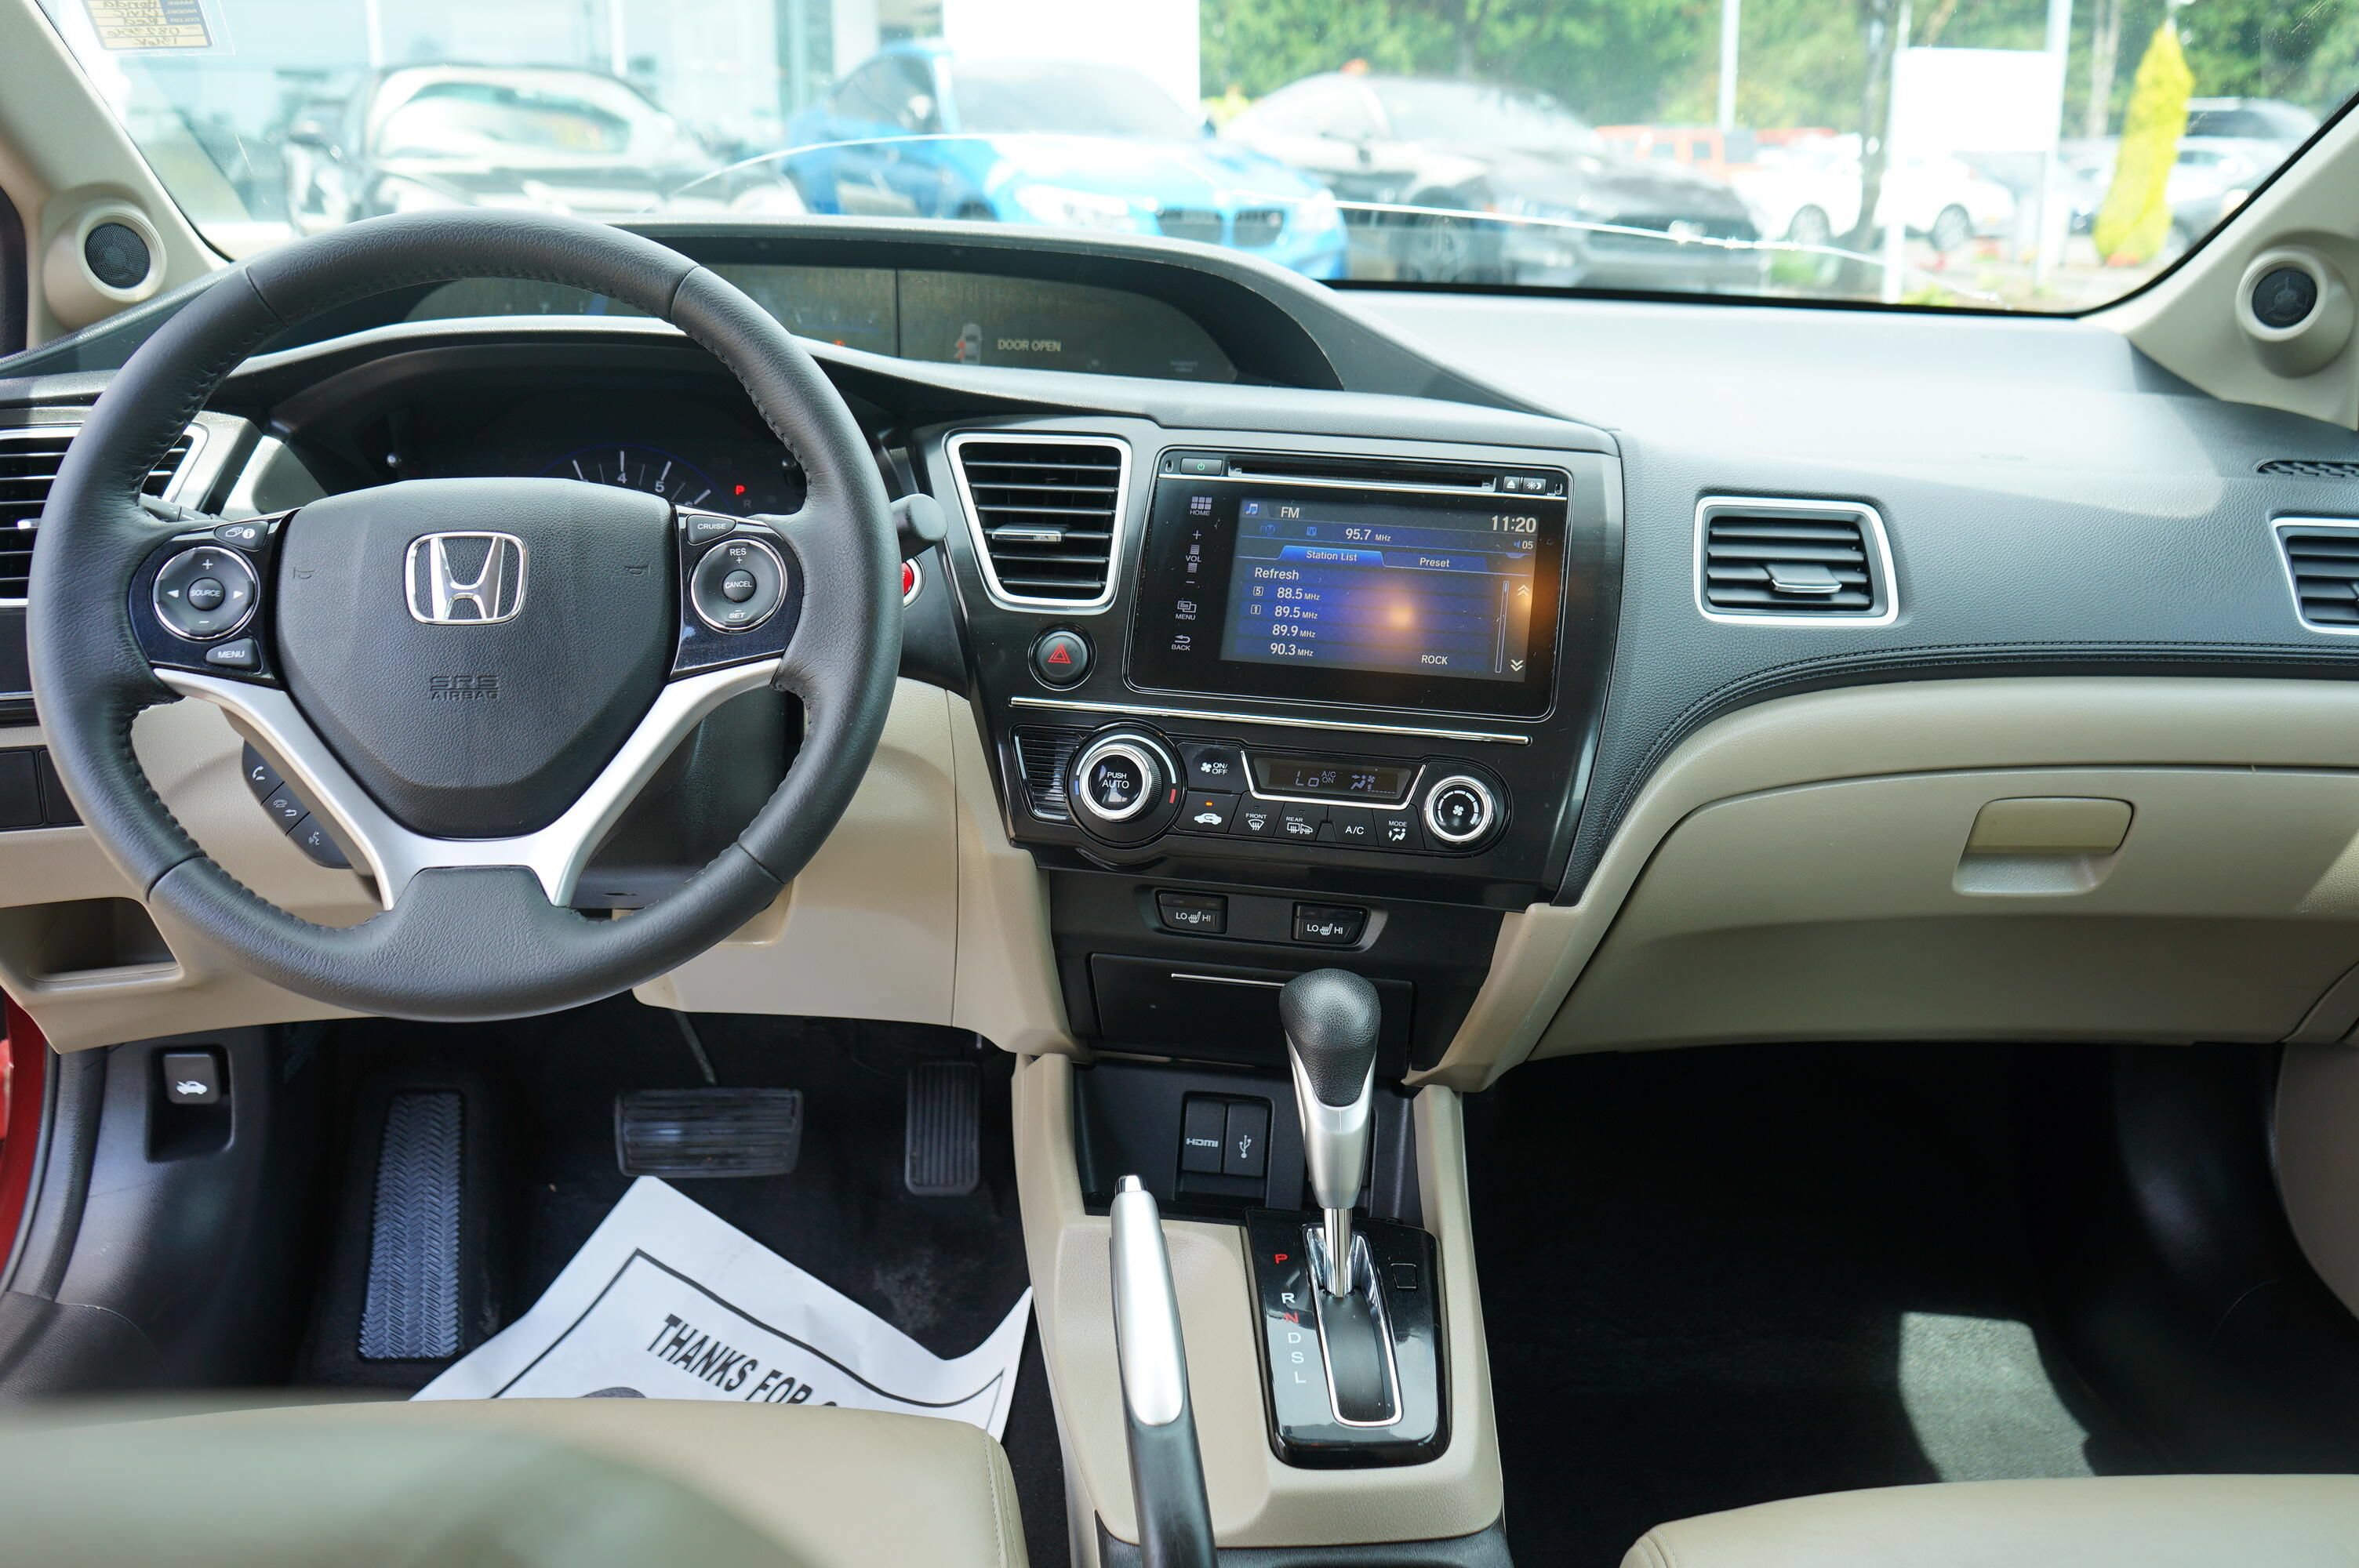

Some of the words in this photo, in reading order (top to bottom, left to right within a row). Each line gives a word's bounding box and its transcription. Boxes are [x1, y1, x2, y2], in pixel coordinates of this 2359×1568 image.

[998, 338, 1029, 351] DOOR
[1030, 339, 1062, 352] OPEN
[654, 481, 666, 492] 5
[735, 485, 746, 495] P
[1281, 506, 1299, 519] FM
[1491, 515, 1537, 533] 11:20
[1345, 528, 1372, 541] 95.7
[1375, 534, 1391, 543] MHz
[1521, 540, 1533, 550] 05
[729, 548, 747, 557] RES
[1306, 550, 1338, 561] Station
[1340, 552, 1358, 562] List
[1419, 557, 1450, 568] Preset
[1255, 567, 1299, 581] Refresh
[725, 580, 753, 589] CANCEL
[190, 589, 220, 597] SOURCE
[1277, 586, 1303, 600] 88.5
[1304, 593, 1321, 601] MHz
[1274, 604, 1300, 619] 89.5
[1302, 611, 1318, 619] MHz
[1272, 623, 1299, 637] 89.9
[1299, 630, 1316, 638] MHz
[217, 650, 245, 659] MENU
[1270, 642, 1296, 655] 90.3
[1297, 648, 1314, 657] MHz
[1422, 655, 1448, 666] ROCK
[1102, 779, 1130, 789] AUTO
[1345, 826, 1365, 835] A/C
[1176, 912, 1187, 920] LO
[1307, 924, 1319, 933] LO
[1334, 926, 1343, 935] HI
[1186, 1138, 1219, 1148] HDMI
[1274, 1254, 1288, 1264] P
[1281, 1292, 1296, 1304] R
[1283, 1311, 1299, 1323] N
[1288, 1332, 1301, 1344] D
[647, 1313, 758, 1392] THANKS
[1291, 1352, 1304, 1363] S
[1295, 1371, 1306, 1384] L
